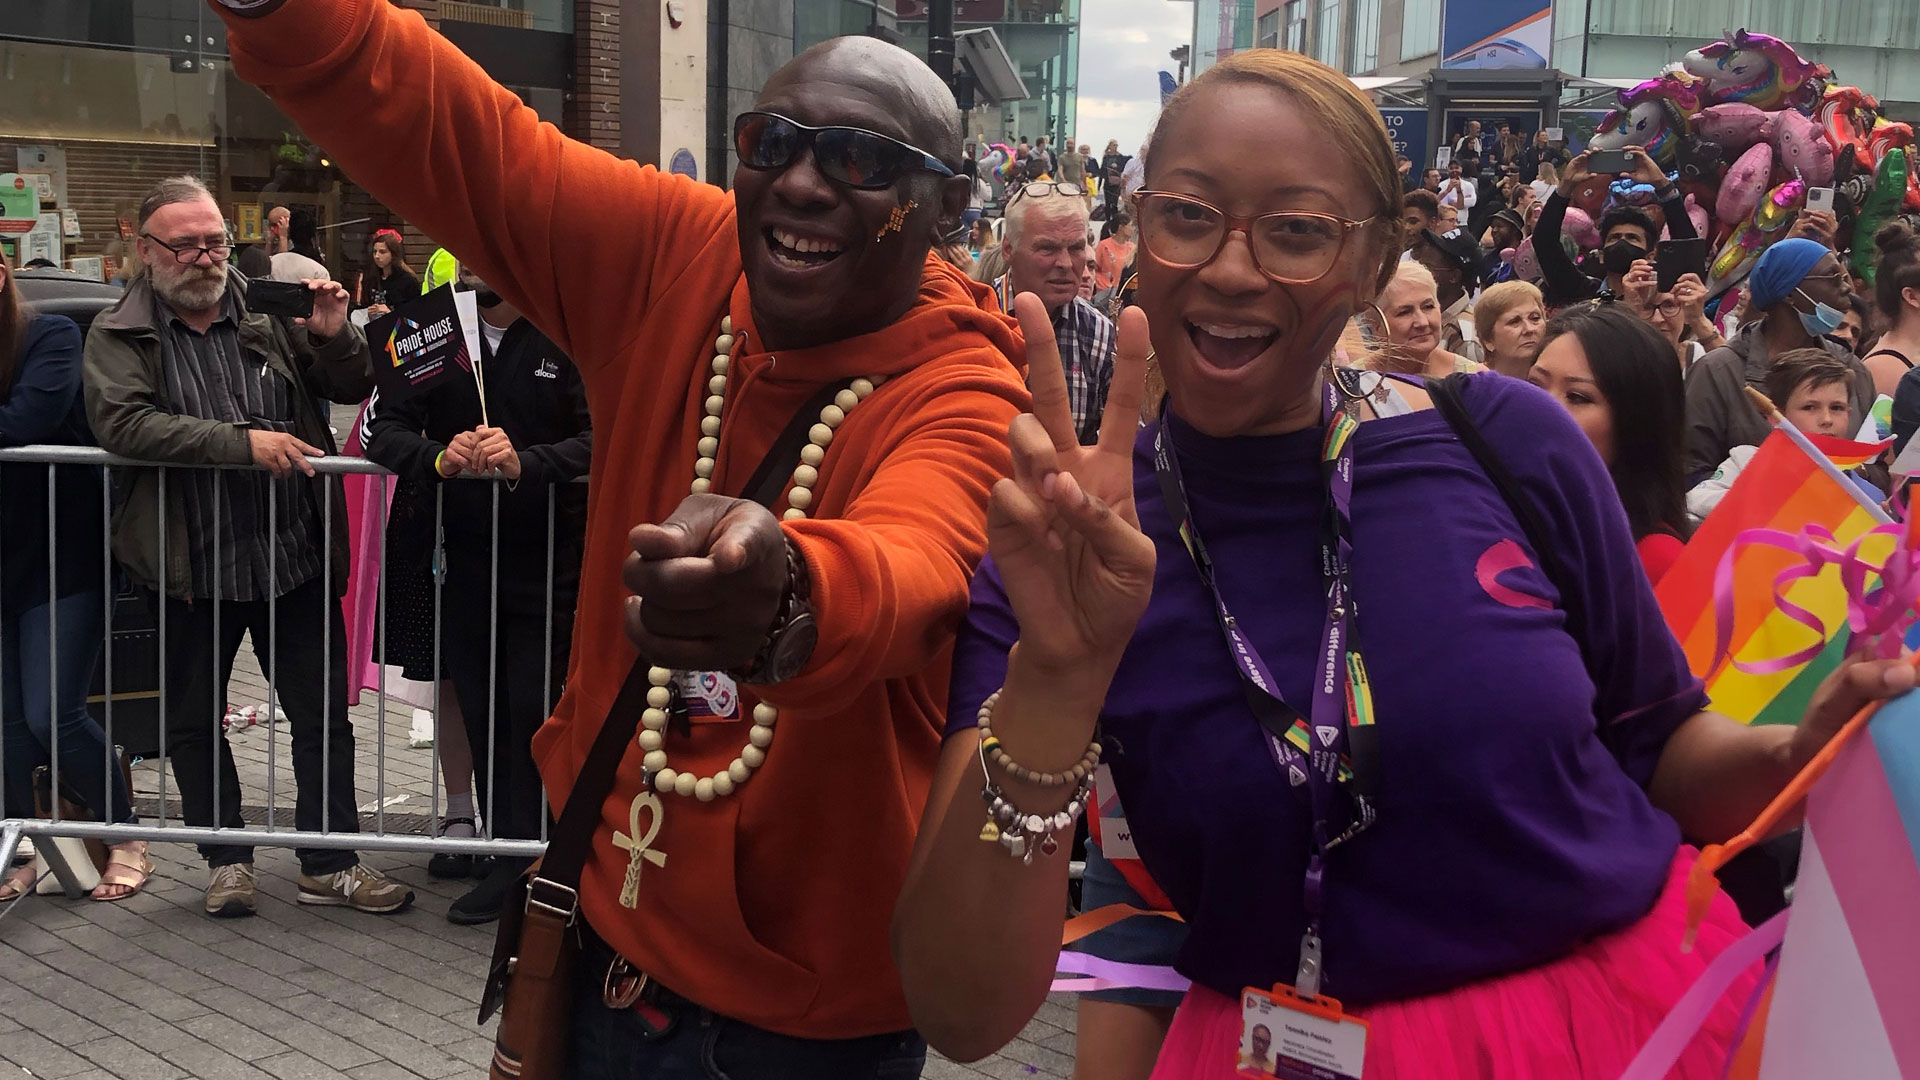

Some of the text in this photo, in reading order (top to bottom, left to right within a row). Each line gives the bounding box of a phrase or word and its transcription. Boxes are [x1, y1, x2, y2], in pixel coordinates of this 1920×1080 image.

[1385, 115, 1404, 126] TO
[1387, 128, 1398, 139] O
[1391, 141, 1408, 152] E?
[396, 331, 424, 357] PRIDE
[422, 316, 454, 343] HOUSE
[1342, 457, 1350, 483] Change
[1323, 545, 1331, 576] Change
[1324, 627, 1339, 694] difference
[1312, 750, 1320, 768] Live
[1319, 751, 1330, 773] Grow
[1325, 751, 1338, 783] Change
